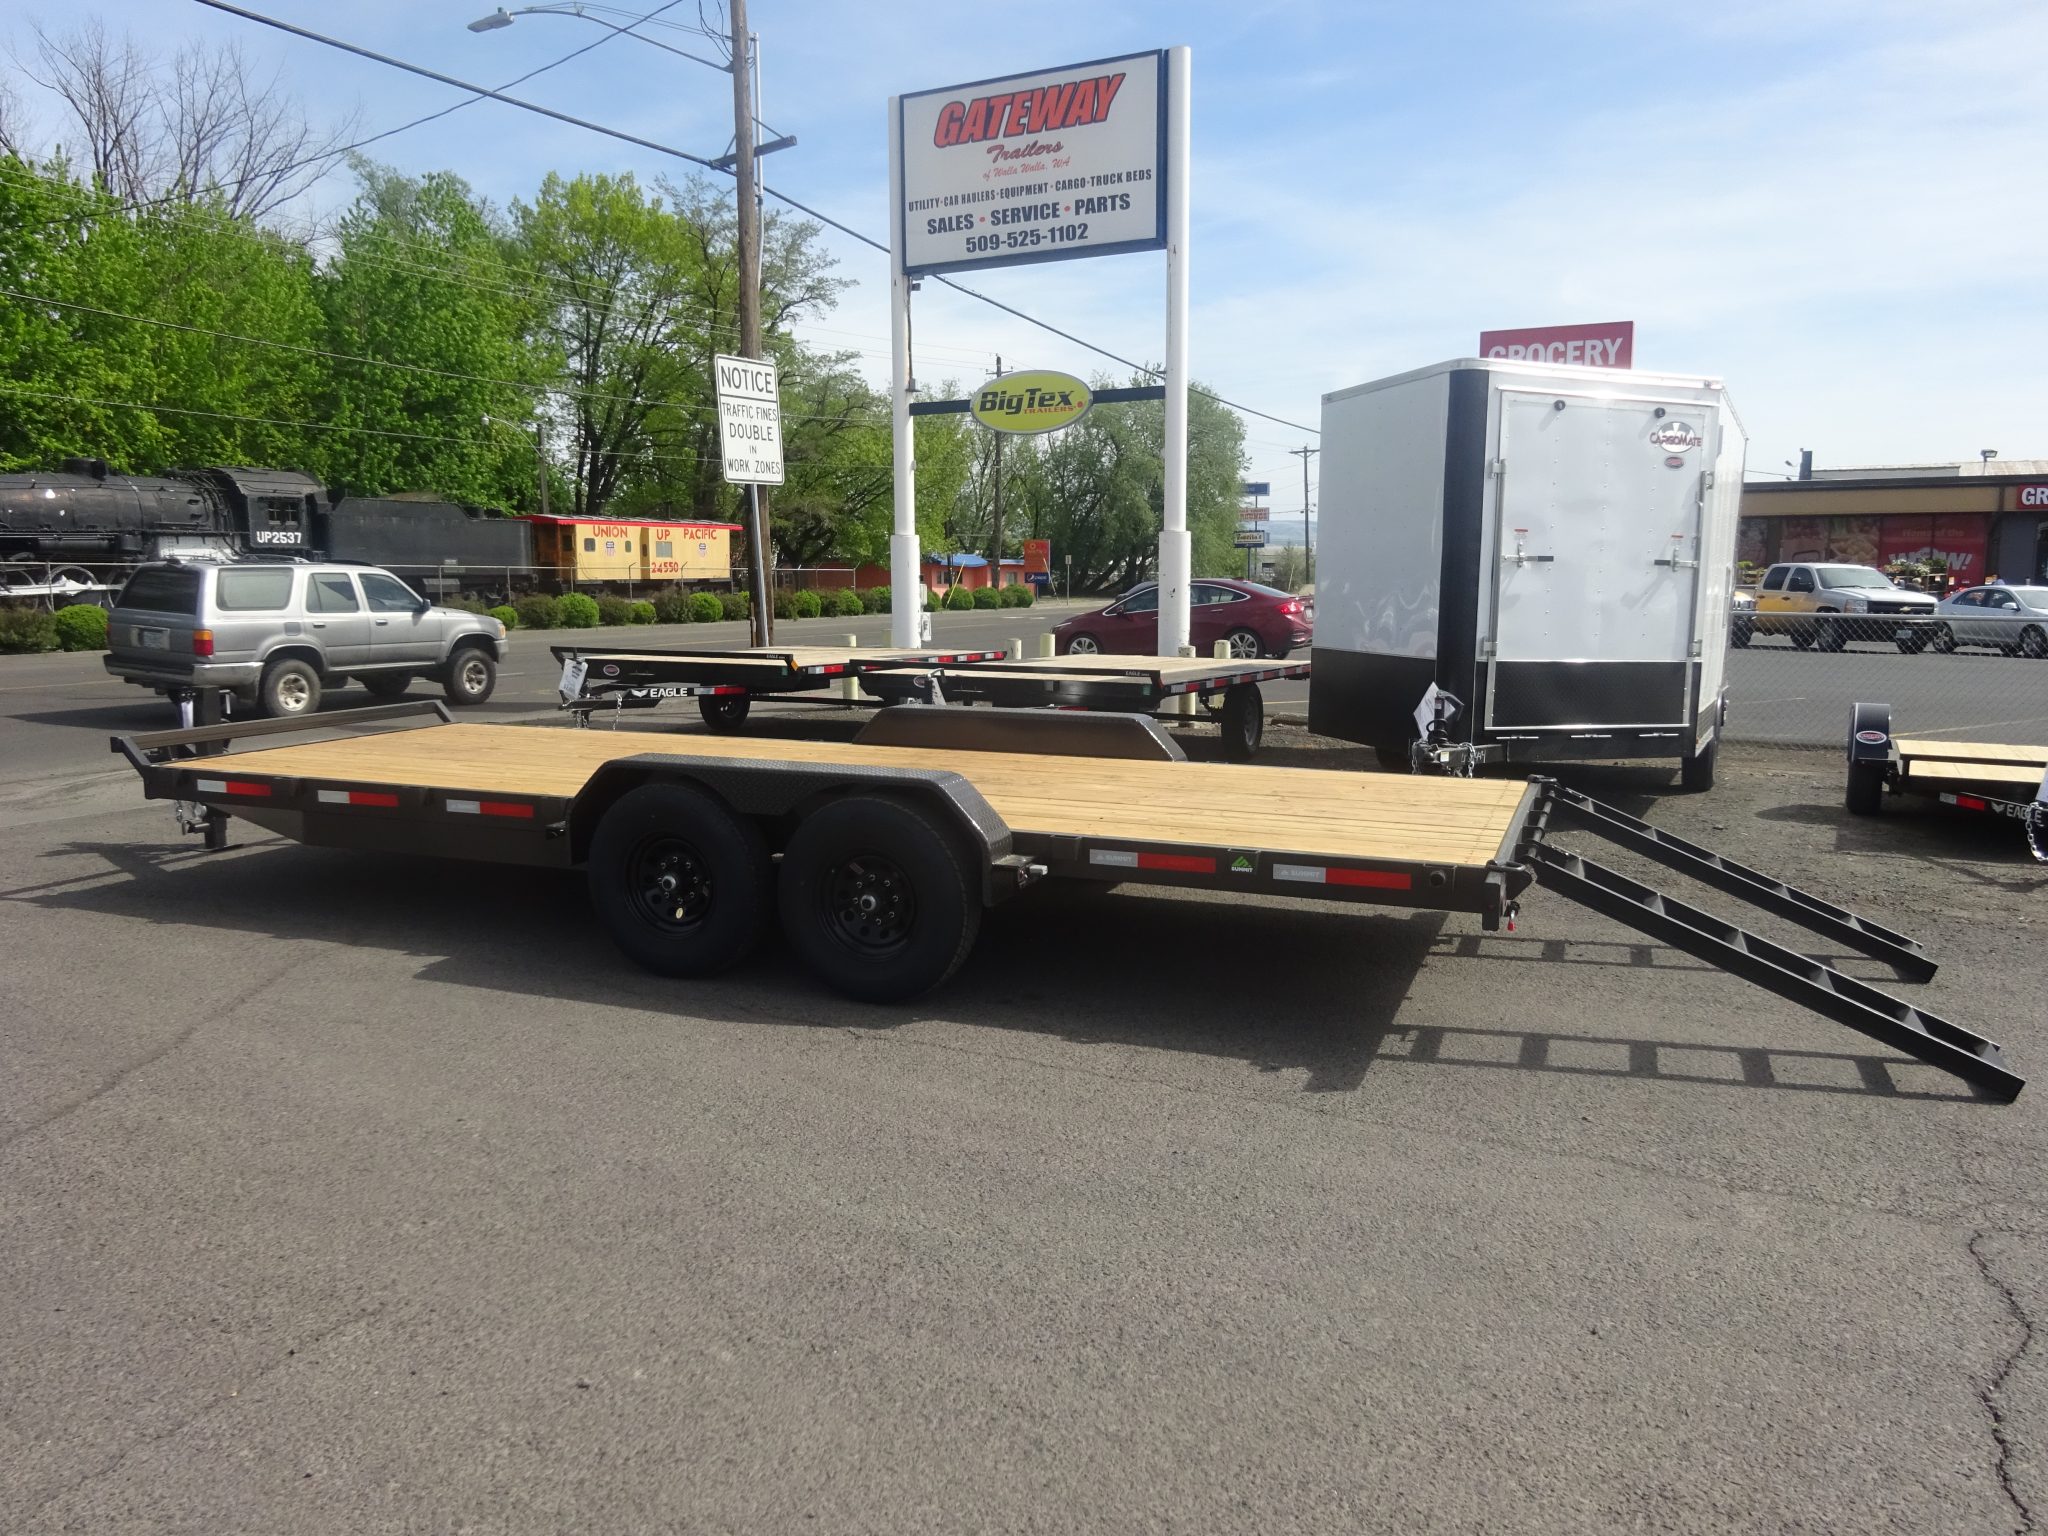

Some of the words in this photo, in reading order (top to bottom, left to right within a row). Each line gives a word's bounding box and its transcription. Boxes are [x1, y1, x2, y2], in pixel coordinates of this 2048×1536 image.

[933, 73, 1126, 148] GATEWAY
[986, 140, 1064, 164] Trailers
[982, 168, 991, 182] of
[993, 166, 1018, 177] Walla
[908, 199, 941, 212] UTILITY
[943, 196, 960, 207] CAR
[961, 193, 996, 205] HAULERS
[1000, 182, 1049, 199] EQUIPMENT
[1055, 177, 1086, 192] CARGO
[1090, 172, 1124, 187] TRUCK
[1125, 169, 1152, 182] BEDS
[927, 213, 974, 235] SALES
[990, 202, 1061, 226] SERVICE
[1074, 193, 1131, 216] PARTS
[965, 222, 1089, 253] 509-525-1102
[720, 365, 774, 394] NOTICE
[721, 402, 754, 419] TRAFFIC
[756, 407, 778, 422] FINES
[1023, 406, 1074, 415] TRAILERS
[729, 422, 774, 441] DOUBLE
[749, 445, 757, 454] IN
[727, 457, 751, 473] WORK
[755, 460, 781, 475] ZONES
[256, 530, 302, 544] UP2537
[592, 525, 628, 538] UNION
[656, 528, 671, 541] UP
[683, 528, 717, 540] PACIFIC
[651, 561, 679, 574] 24550
[649, 687, 688, 698] EAGLE
